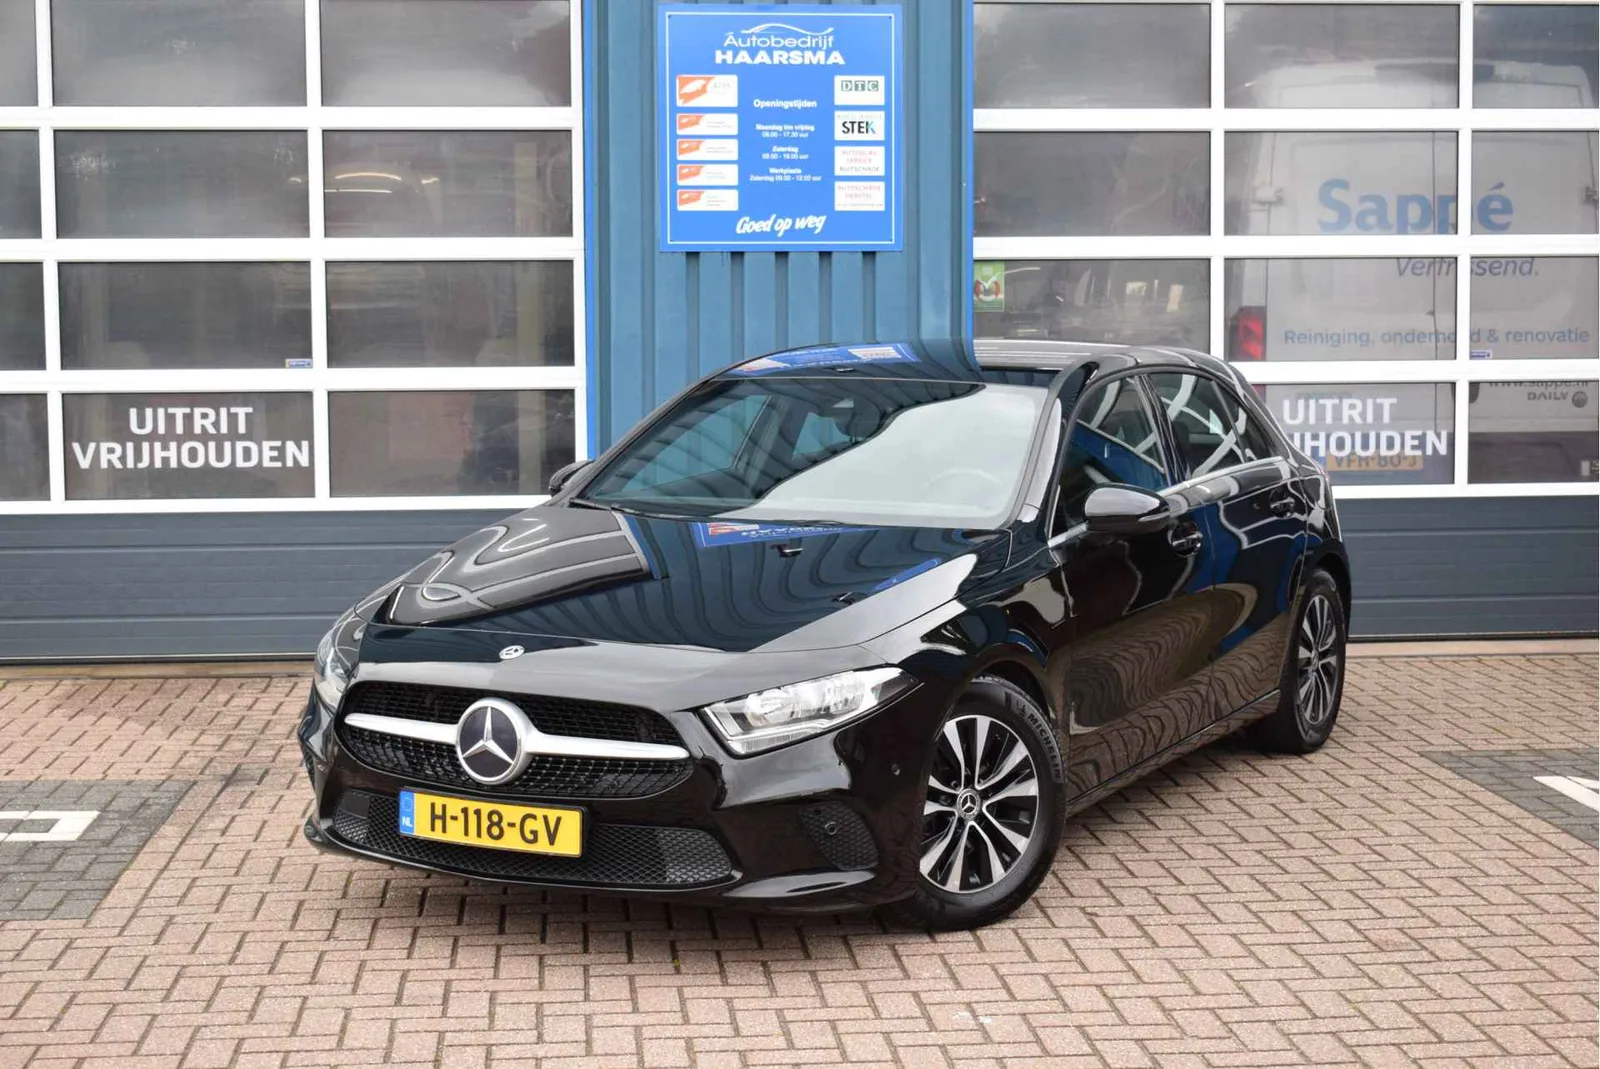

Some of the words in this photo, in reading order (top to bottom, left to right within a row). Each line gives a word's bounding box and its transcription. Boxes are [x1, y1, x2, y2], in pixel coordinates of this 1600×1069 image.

[723, 33, 834, 50] Autobedrijf
[715, 50, 846, 65] HAARSMA
[841, 80, 879, 91] DTC
[753, 98, 818, 109] Openingstijden
[842, 120, 876, 134] STEK
[736, 214, 775, 234] Goed
[774, 220, 791, 237] op
[794, 214, 827, 234] weg
[1396, 257, 1540, 277] Verfrssend.
[1284, 329, 1375, 347] Reiniging,
[1381, 329, 1480, 344] onderhod
[1486, 330, 1500, 343] &
[1505, 329, 1590, 343] renovatie
[1283, 398, 1397, 425] UITRIT
[129, 407, 253, 435] UITRIT
[71, 440, 310, 469] VRIJHOUDEN
[402, 816, 414, 828] NL
[430, 802, 562, 846] H-118-GV
